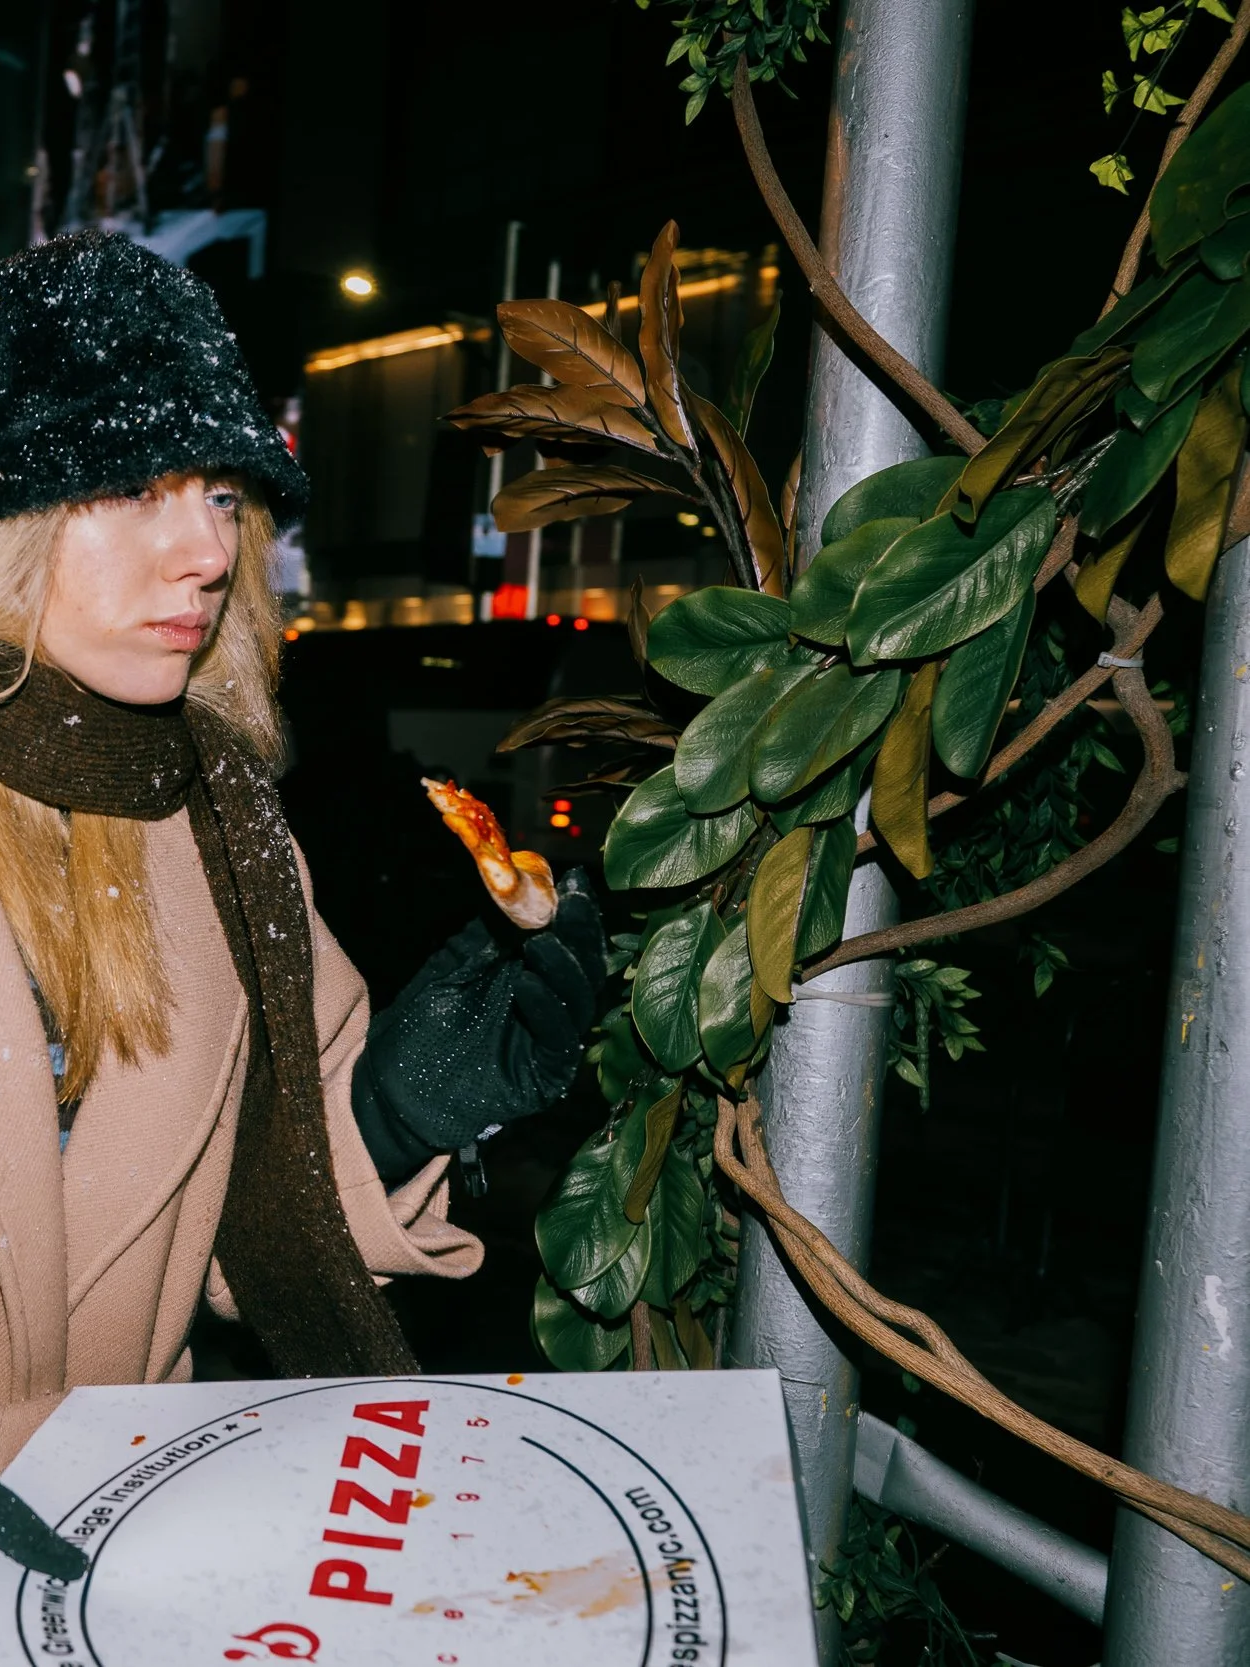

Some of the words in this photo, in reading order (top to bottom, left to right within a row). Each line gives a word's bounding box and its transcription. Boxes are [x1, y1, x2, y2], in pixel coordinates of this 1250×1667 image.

[37, 1576, 74, 1656] Greenwic
[100, 1432, 220, 1503] Institution
[309, 1400, 430, 1606] PIZZA
[625, 1486, 709, 1667] spizzanyc.com
